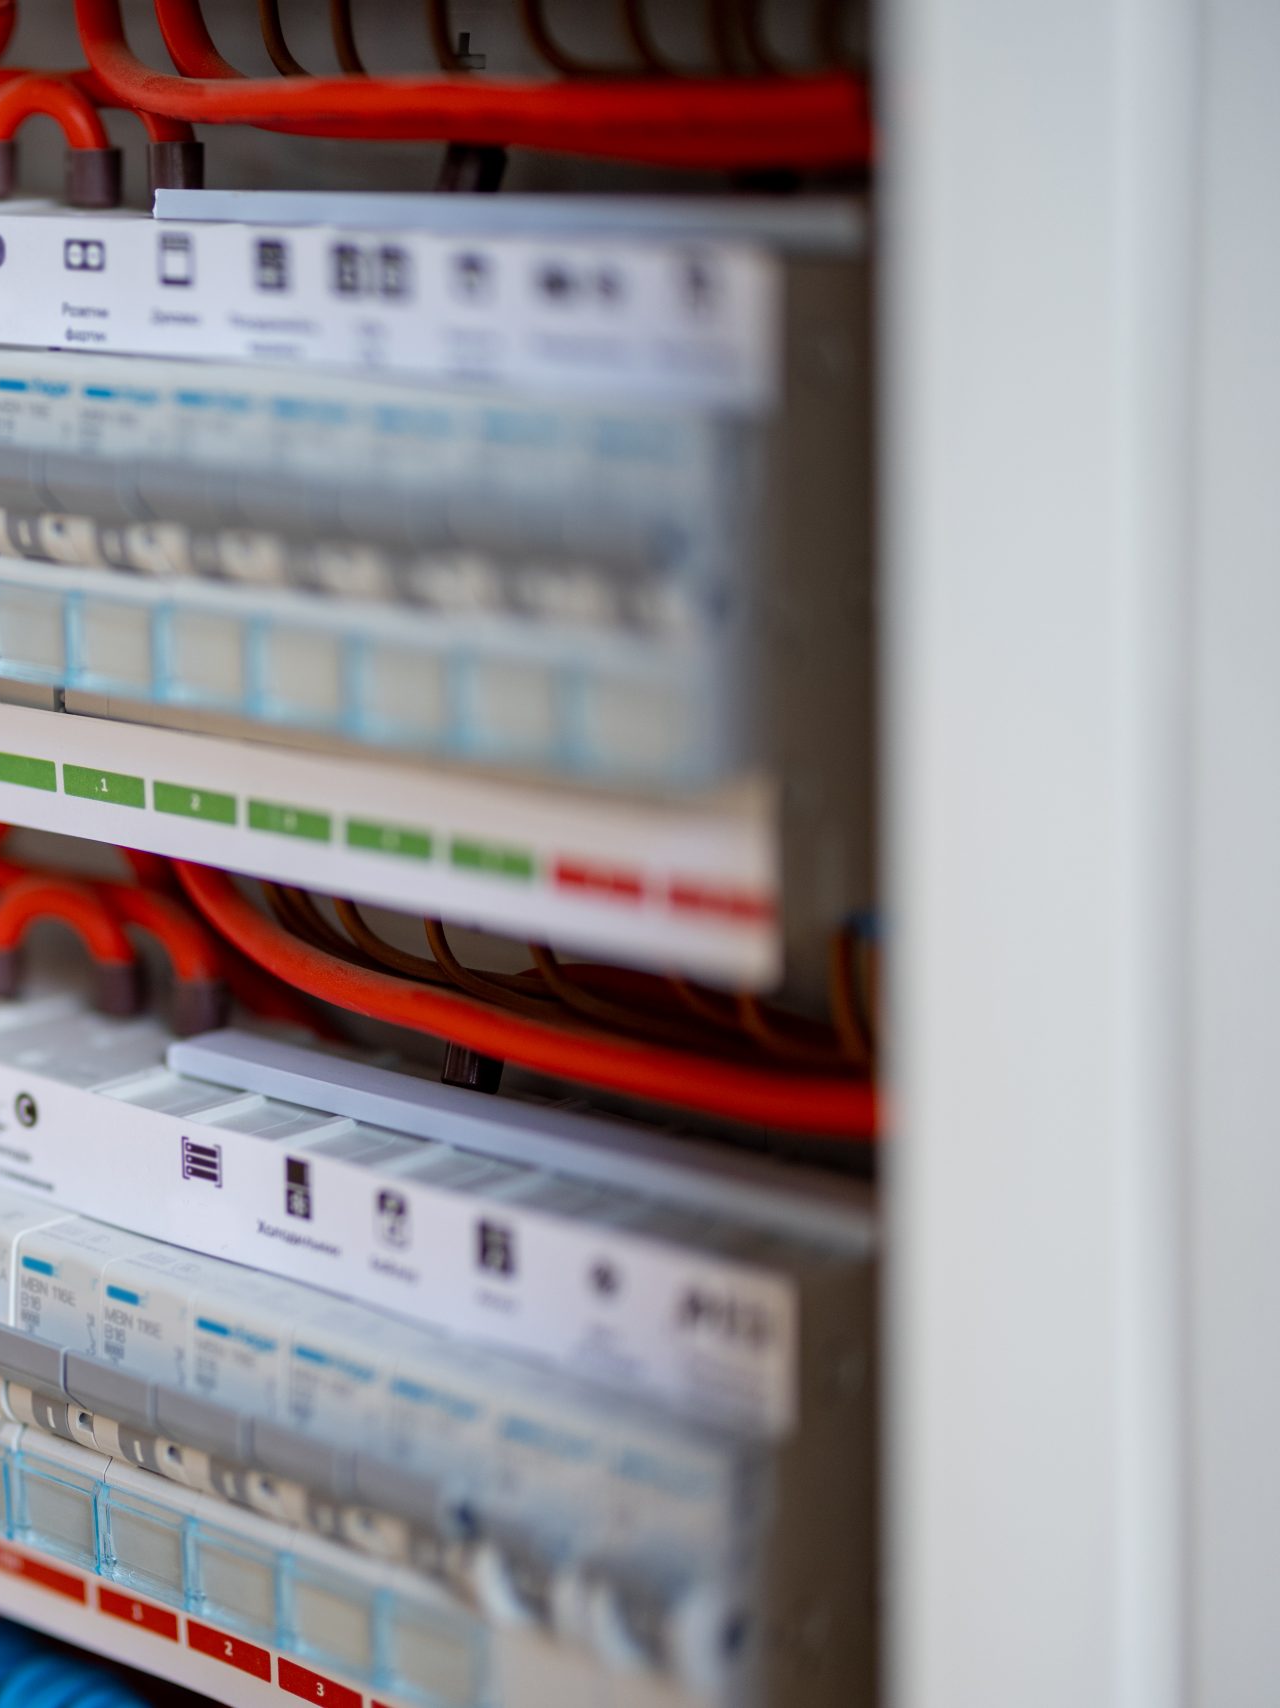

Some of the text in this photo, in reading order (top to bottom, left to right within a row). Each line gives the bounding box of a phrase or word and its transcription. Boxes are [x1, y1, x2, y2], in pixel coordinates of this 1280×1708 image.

[100, 778, 108, 792] 1
[223, 1640, 234, 1657] 2
[316, 1682, 325, 1697] 3
